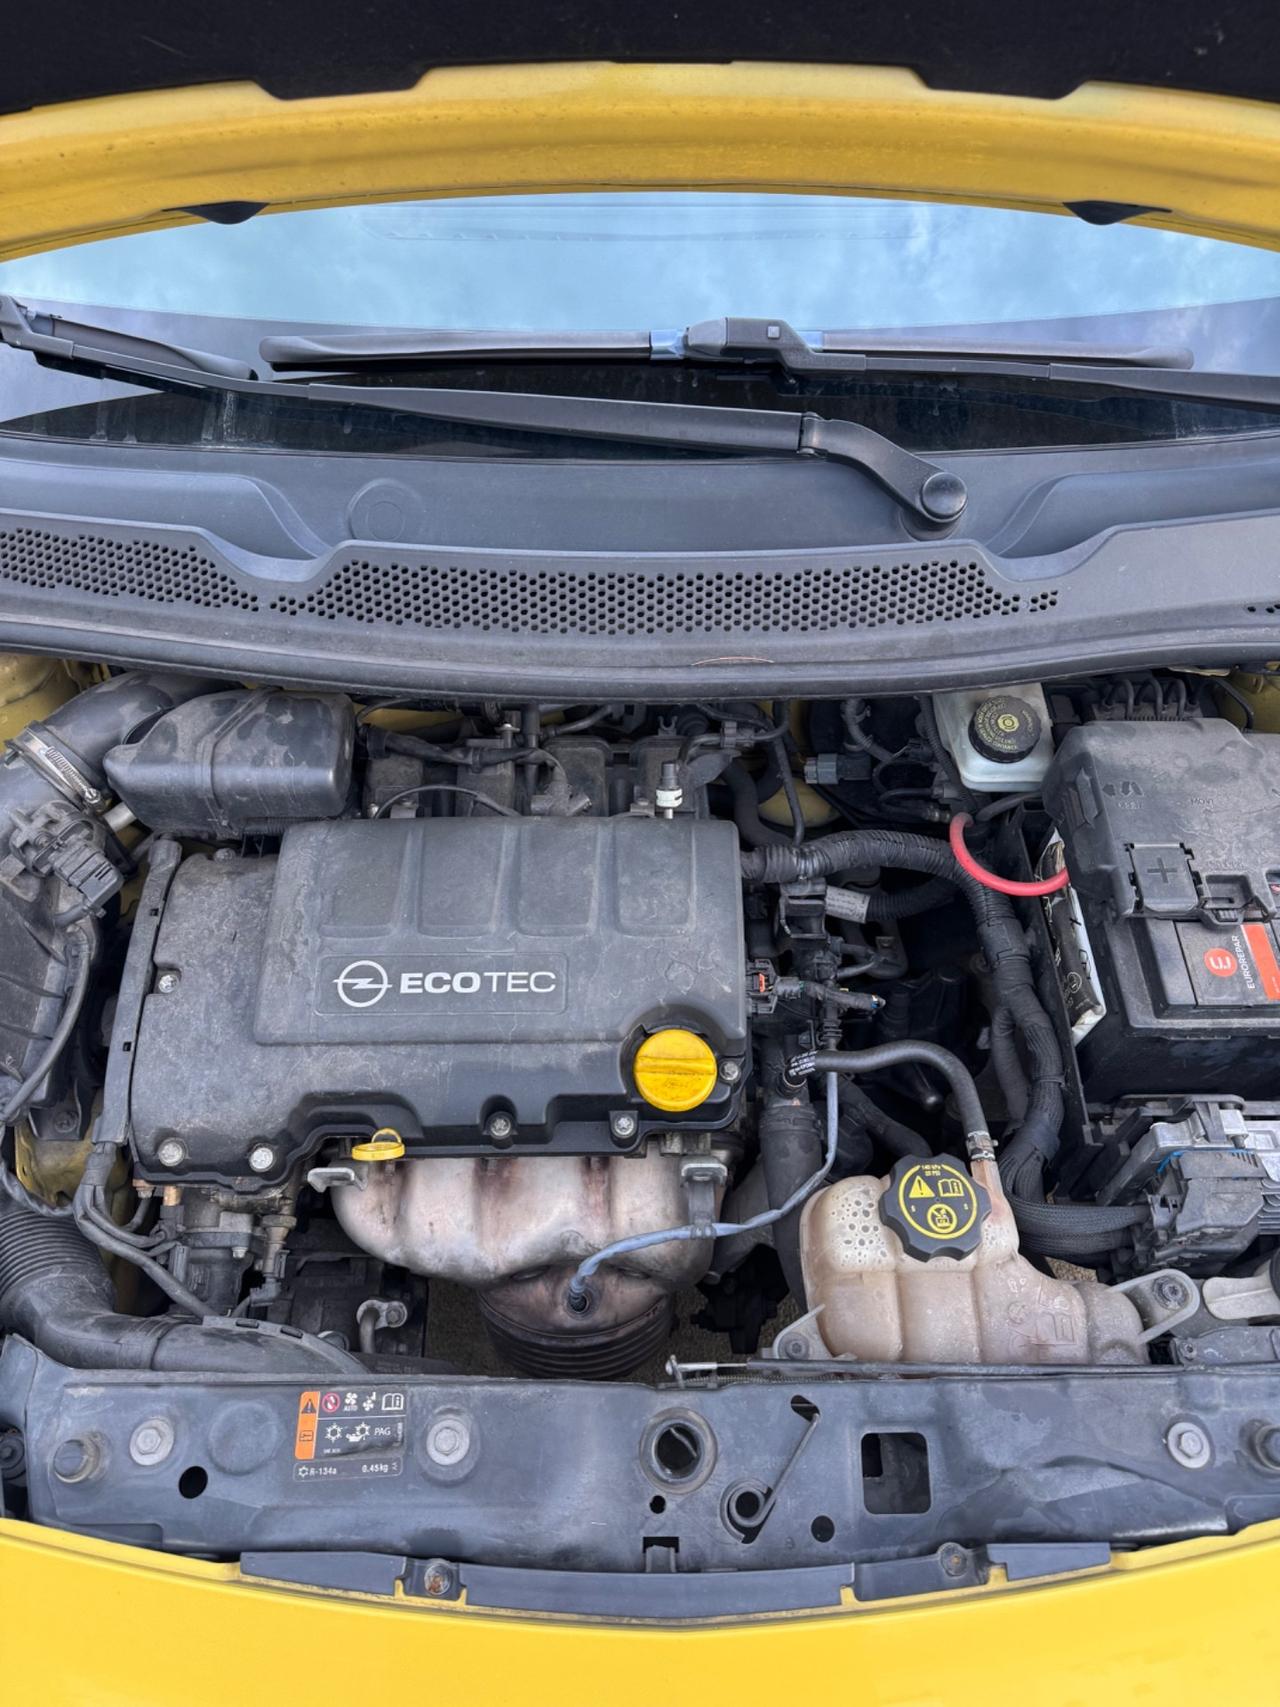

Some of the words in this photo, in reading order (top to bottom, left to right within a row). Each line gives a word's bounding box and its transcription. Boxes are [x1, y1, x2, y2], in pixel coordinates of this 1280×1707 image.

[1231, 935, 1256, 989] EUROREPAR
[399, 971, 557, 994] ECOTEC
[343, 1404, 359, 1412] AUTO
[374, 1427, 391, 1436] PAG
[309, 1466, 337, 1476] R-134a
